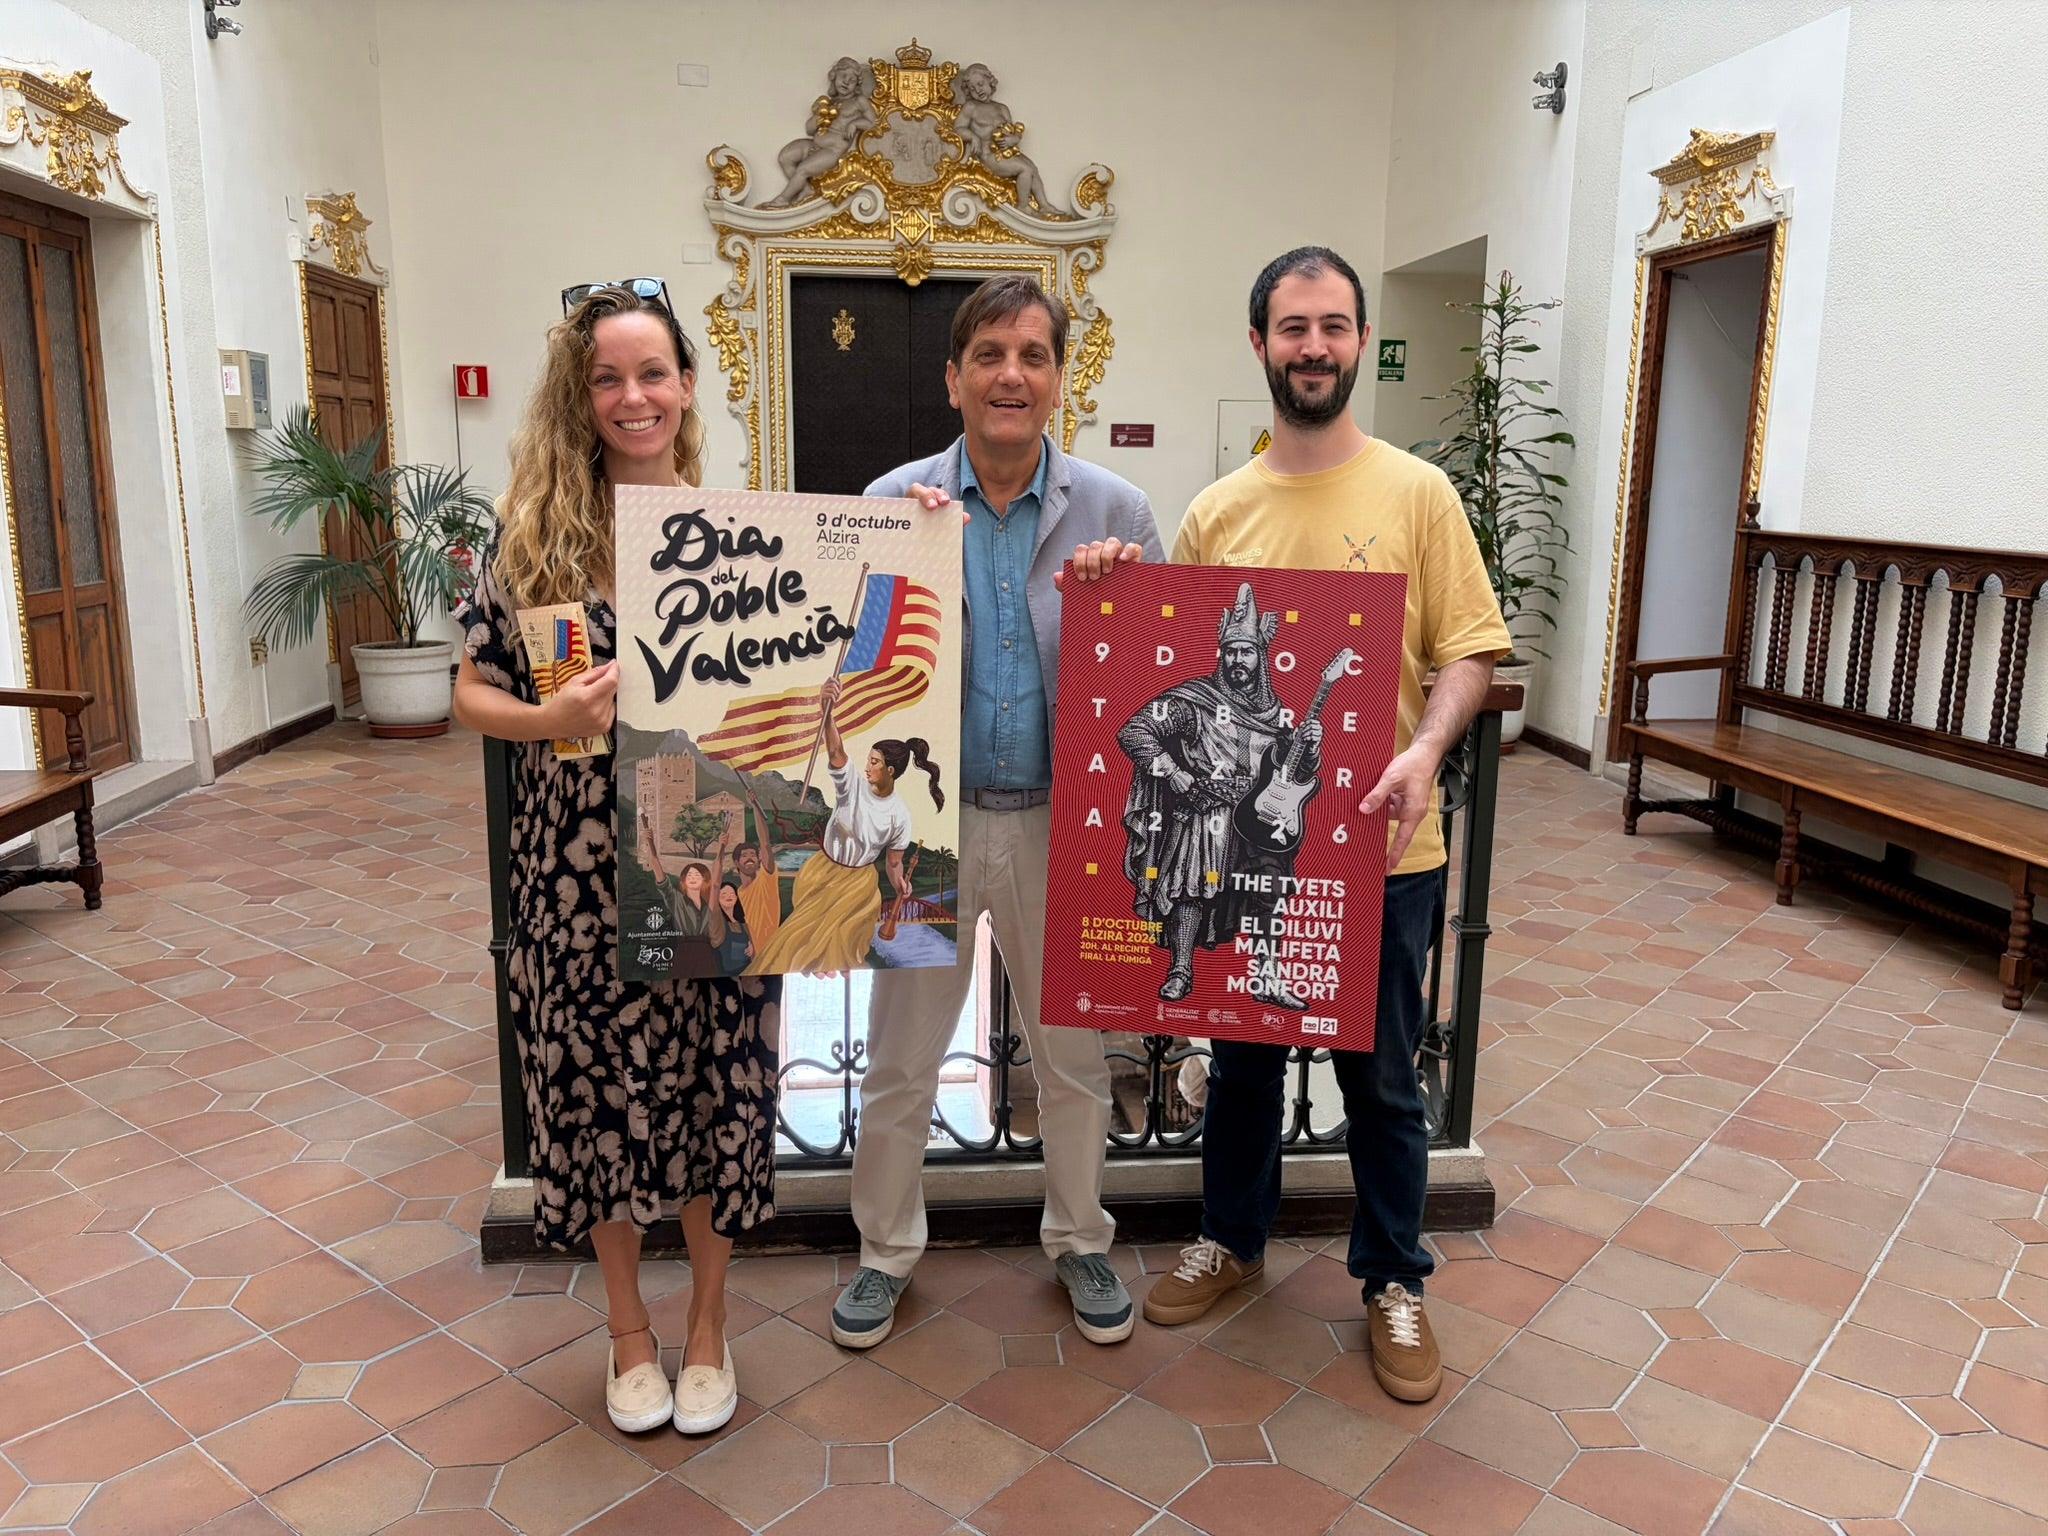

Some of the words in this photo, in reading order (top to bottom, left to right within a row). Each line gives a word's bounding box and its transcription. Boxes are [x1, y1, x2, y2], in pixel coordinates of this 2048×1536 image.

[816, 512, 828, 527] 9
[831, 513, 912, 531] d'octubre
[816, 529, 861, 545] Alzira
[816, 545, 857, 561] 2026
[1223, 547, 1263, 563] WAVES
[711, 565, 739, 586] del
[655, 566, 807, 647] Poble
[634, 606, 855, 704] Valencià
[1095, 642, 1110, 662] 9
[1231, 873, 1273, 893] THE
[1278, 876, 1345, 898] TYETS
[1272, 897, 1344, 919] AUXILI
[1082, 916, 1090, 927] 8
[1092, 917, 1163, 933] D'OCTUBRE
[1240, 916, 1264, 935] EL
[1270, 917, 1342, 940] DILUVI
[627, 931, 661, 939] Ajuntament
[1081, 929, 1124, 942] ALZIRA
[1127, 932, 1157, 944] 2026
[1102, 943, 1113, 951] AL
[1114, 944, 1150, 954] RECINTE
[1105, 954, 1116, 962] LA
[1235, 936, 1341, 962] MALIFETA
[1246, 958, 1340, 983] SANDRA
[1226, 975, 1340, 1001] MONFORT
[1322, 1021, 1335, 1032] 21
